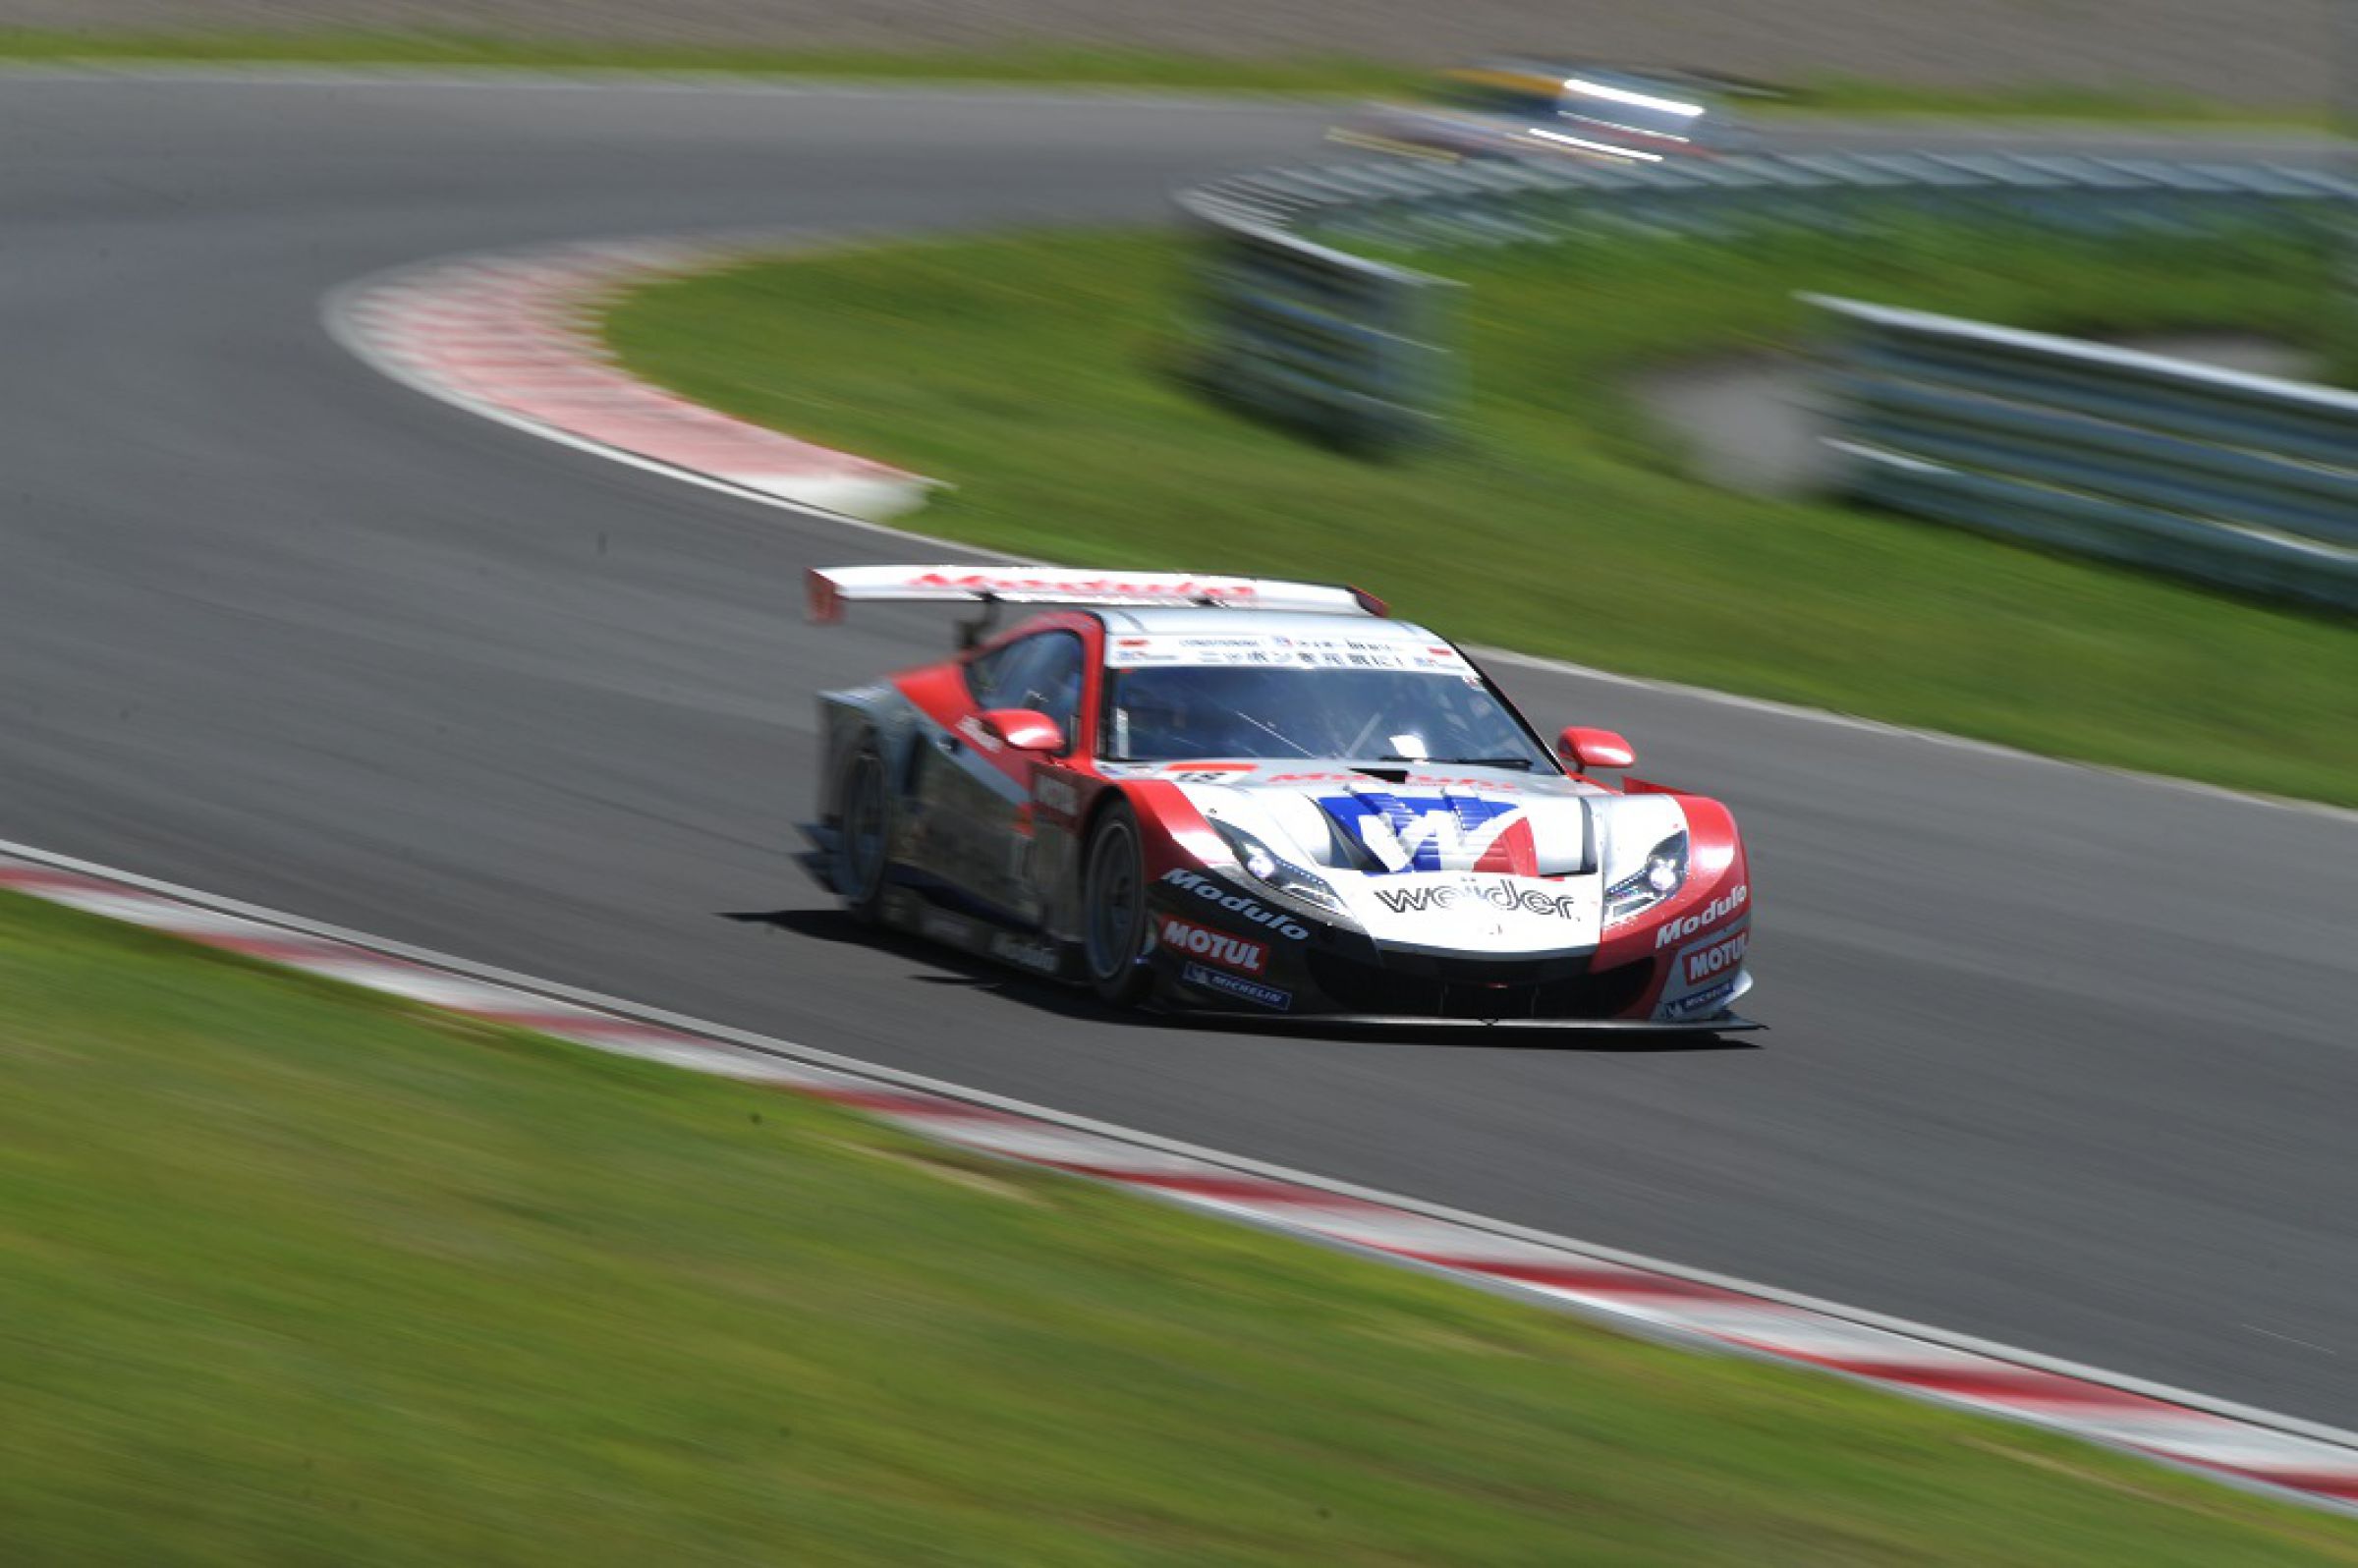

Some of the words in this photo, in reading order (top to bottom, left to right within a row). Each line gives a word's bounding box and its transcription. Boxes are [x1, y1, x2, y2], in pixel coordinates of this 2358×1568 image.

[1161, 868, 1310, 940] Modulo
[1375, 877, 1574, 920] weider
[1656, 885, 1747, 948] Modulo
[1163, 921, 1261, 970] MOTUL
[1211, 975, 1283, 1003] MICHELIN
